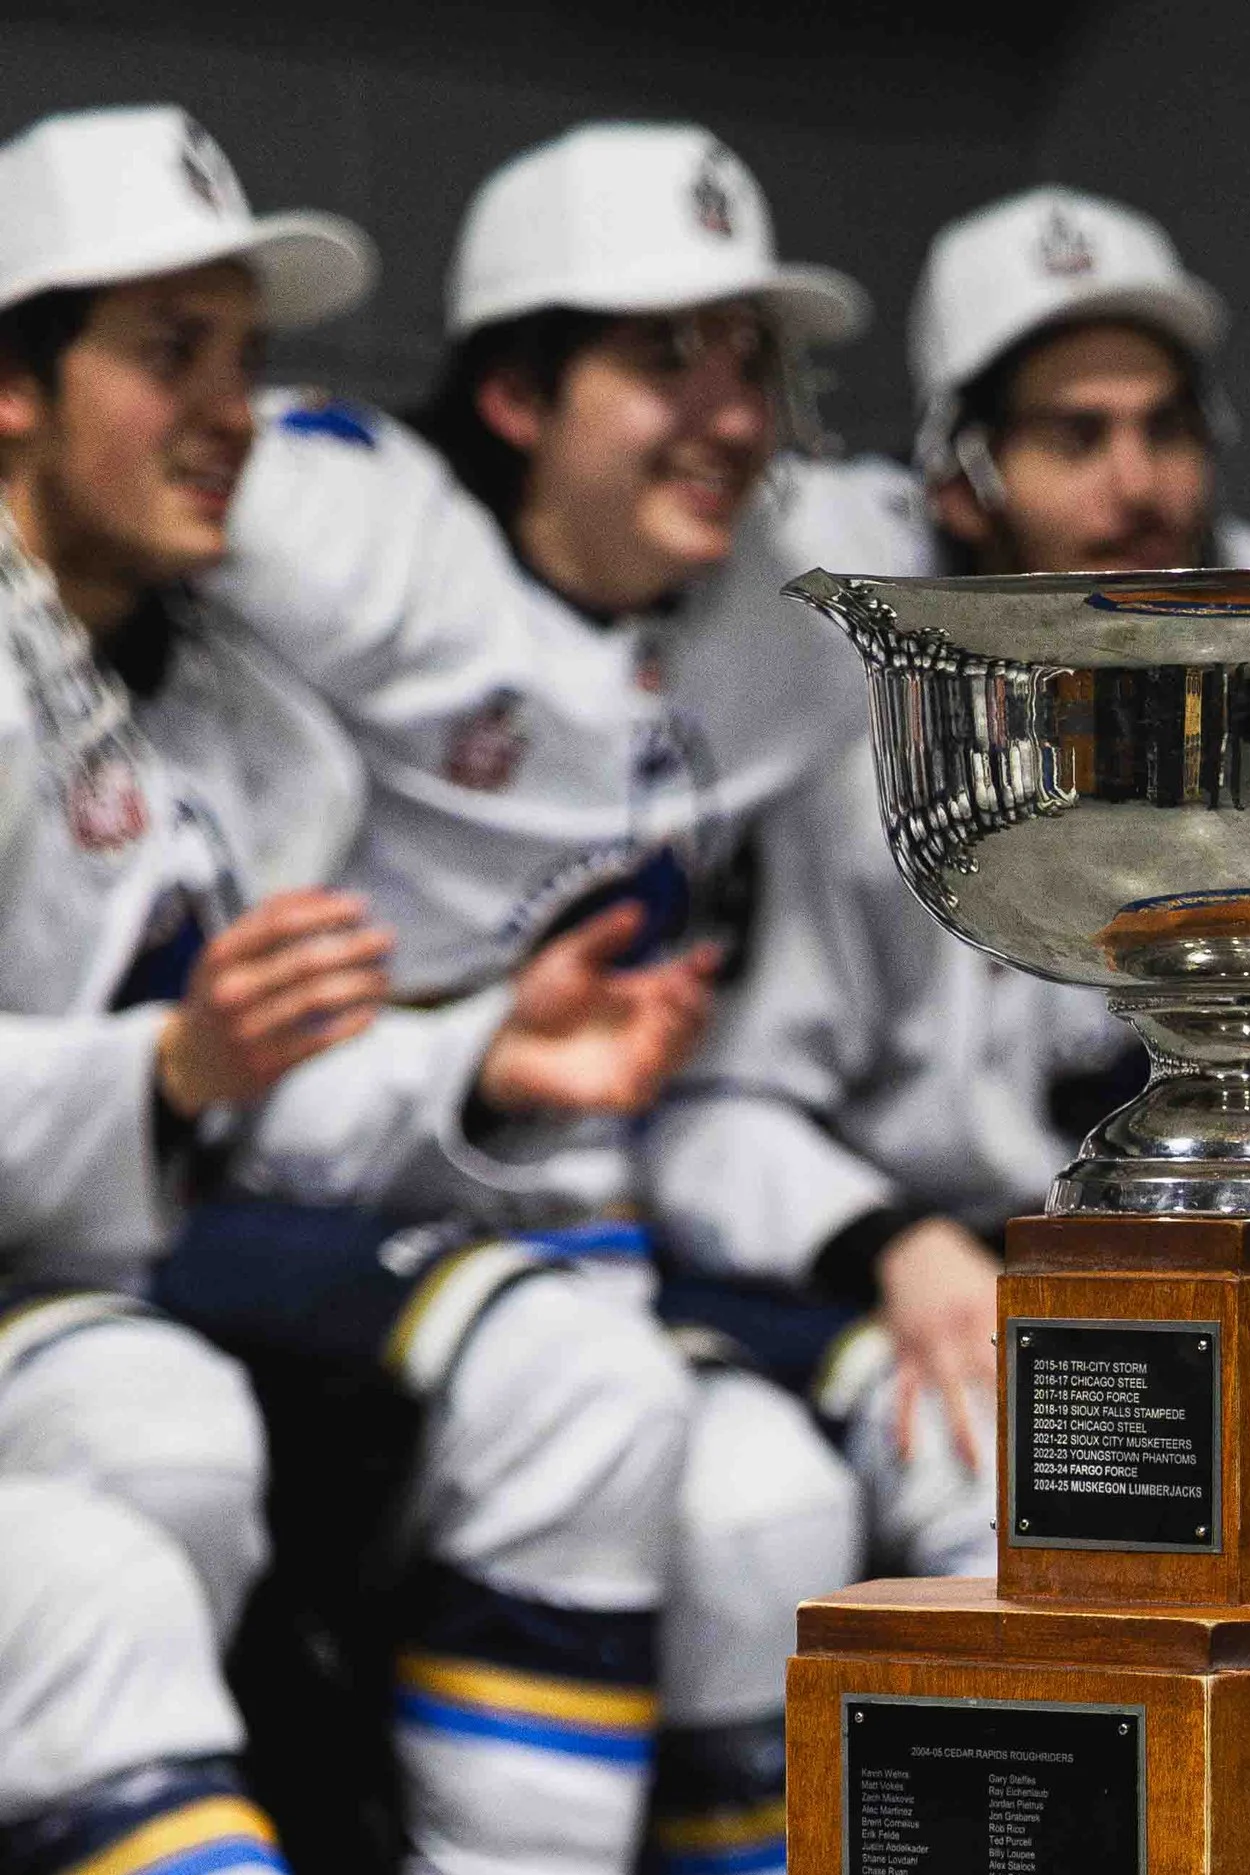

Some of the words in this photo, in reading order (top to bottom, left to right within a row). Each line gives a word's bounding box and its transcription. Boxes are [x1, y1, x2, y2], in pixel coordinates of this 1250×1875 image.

[1034, 1359, 1068, 1370] 2015-16
[1070, 1360, 1110, 1371] TRI-CITY
[1112, 1362, 1147, 1373] STORM
[1033, 1374, 1068, 1385] 2016-17
[1070, 1375, 1115, 1387] CHICAGO
[1117, 1377, 1146, 1388] STEEL
[1033, 1388, 1068, 1400] 2017-18
[1070, 1389, 1104, 1401] FARGO
[1106, 1391, 1139, 1403] FORCE
[1033, 1403, 1068, 1415] 2018-19
[1070, 1405, 1099, 1416] SIOUX
[1102, 1406, 1131, 1417] FALLS
[1133, 1407, 1185, 1419] STAMPEDE
[1033, 1418, 1067, 1429] 2020-21
[1069, 1419, 1114, 1431] CHICAGO
[1117, 1421, 1146, 1433] STEEL
[1033, 1432, 1068, 1444] 2021-22
[1070, 1434, 1099, 1445] SIOUX
[1101, 1435, 1123, 1446] CITY
[1126, 1436, 1191, 1449] MUSKETEERS
[1033, 1447, 1067, 1459] 2022-23
[1069, 1449, 1139, 1462] YOUNGSTOWN
[1142, 1452, 1196, 1464] PHANTOMS
[1033, 1462, 1068, 1474] 2023-24
[1069, 1464, 1103, 1475] FARGO
[1104, 1465, 1137, 1477] FORCE
[1033, 1478, 1068, 1491] 2024-25
[1070, 1480, 1126, 1493] MUSKEGON
[1128, 1483, 1201, 1497] LUMBERJACKS
[943, 1747, 974, 1758] CEDAR
[975, 1749, 1007, 1759] RAPIDS
